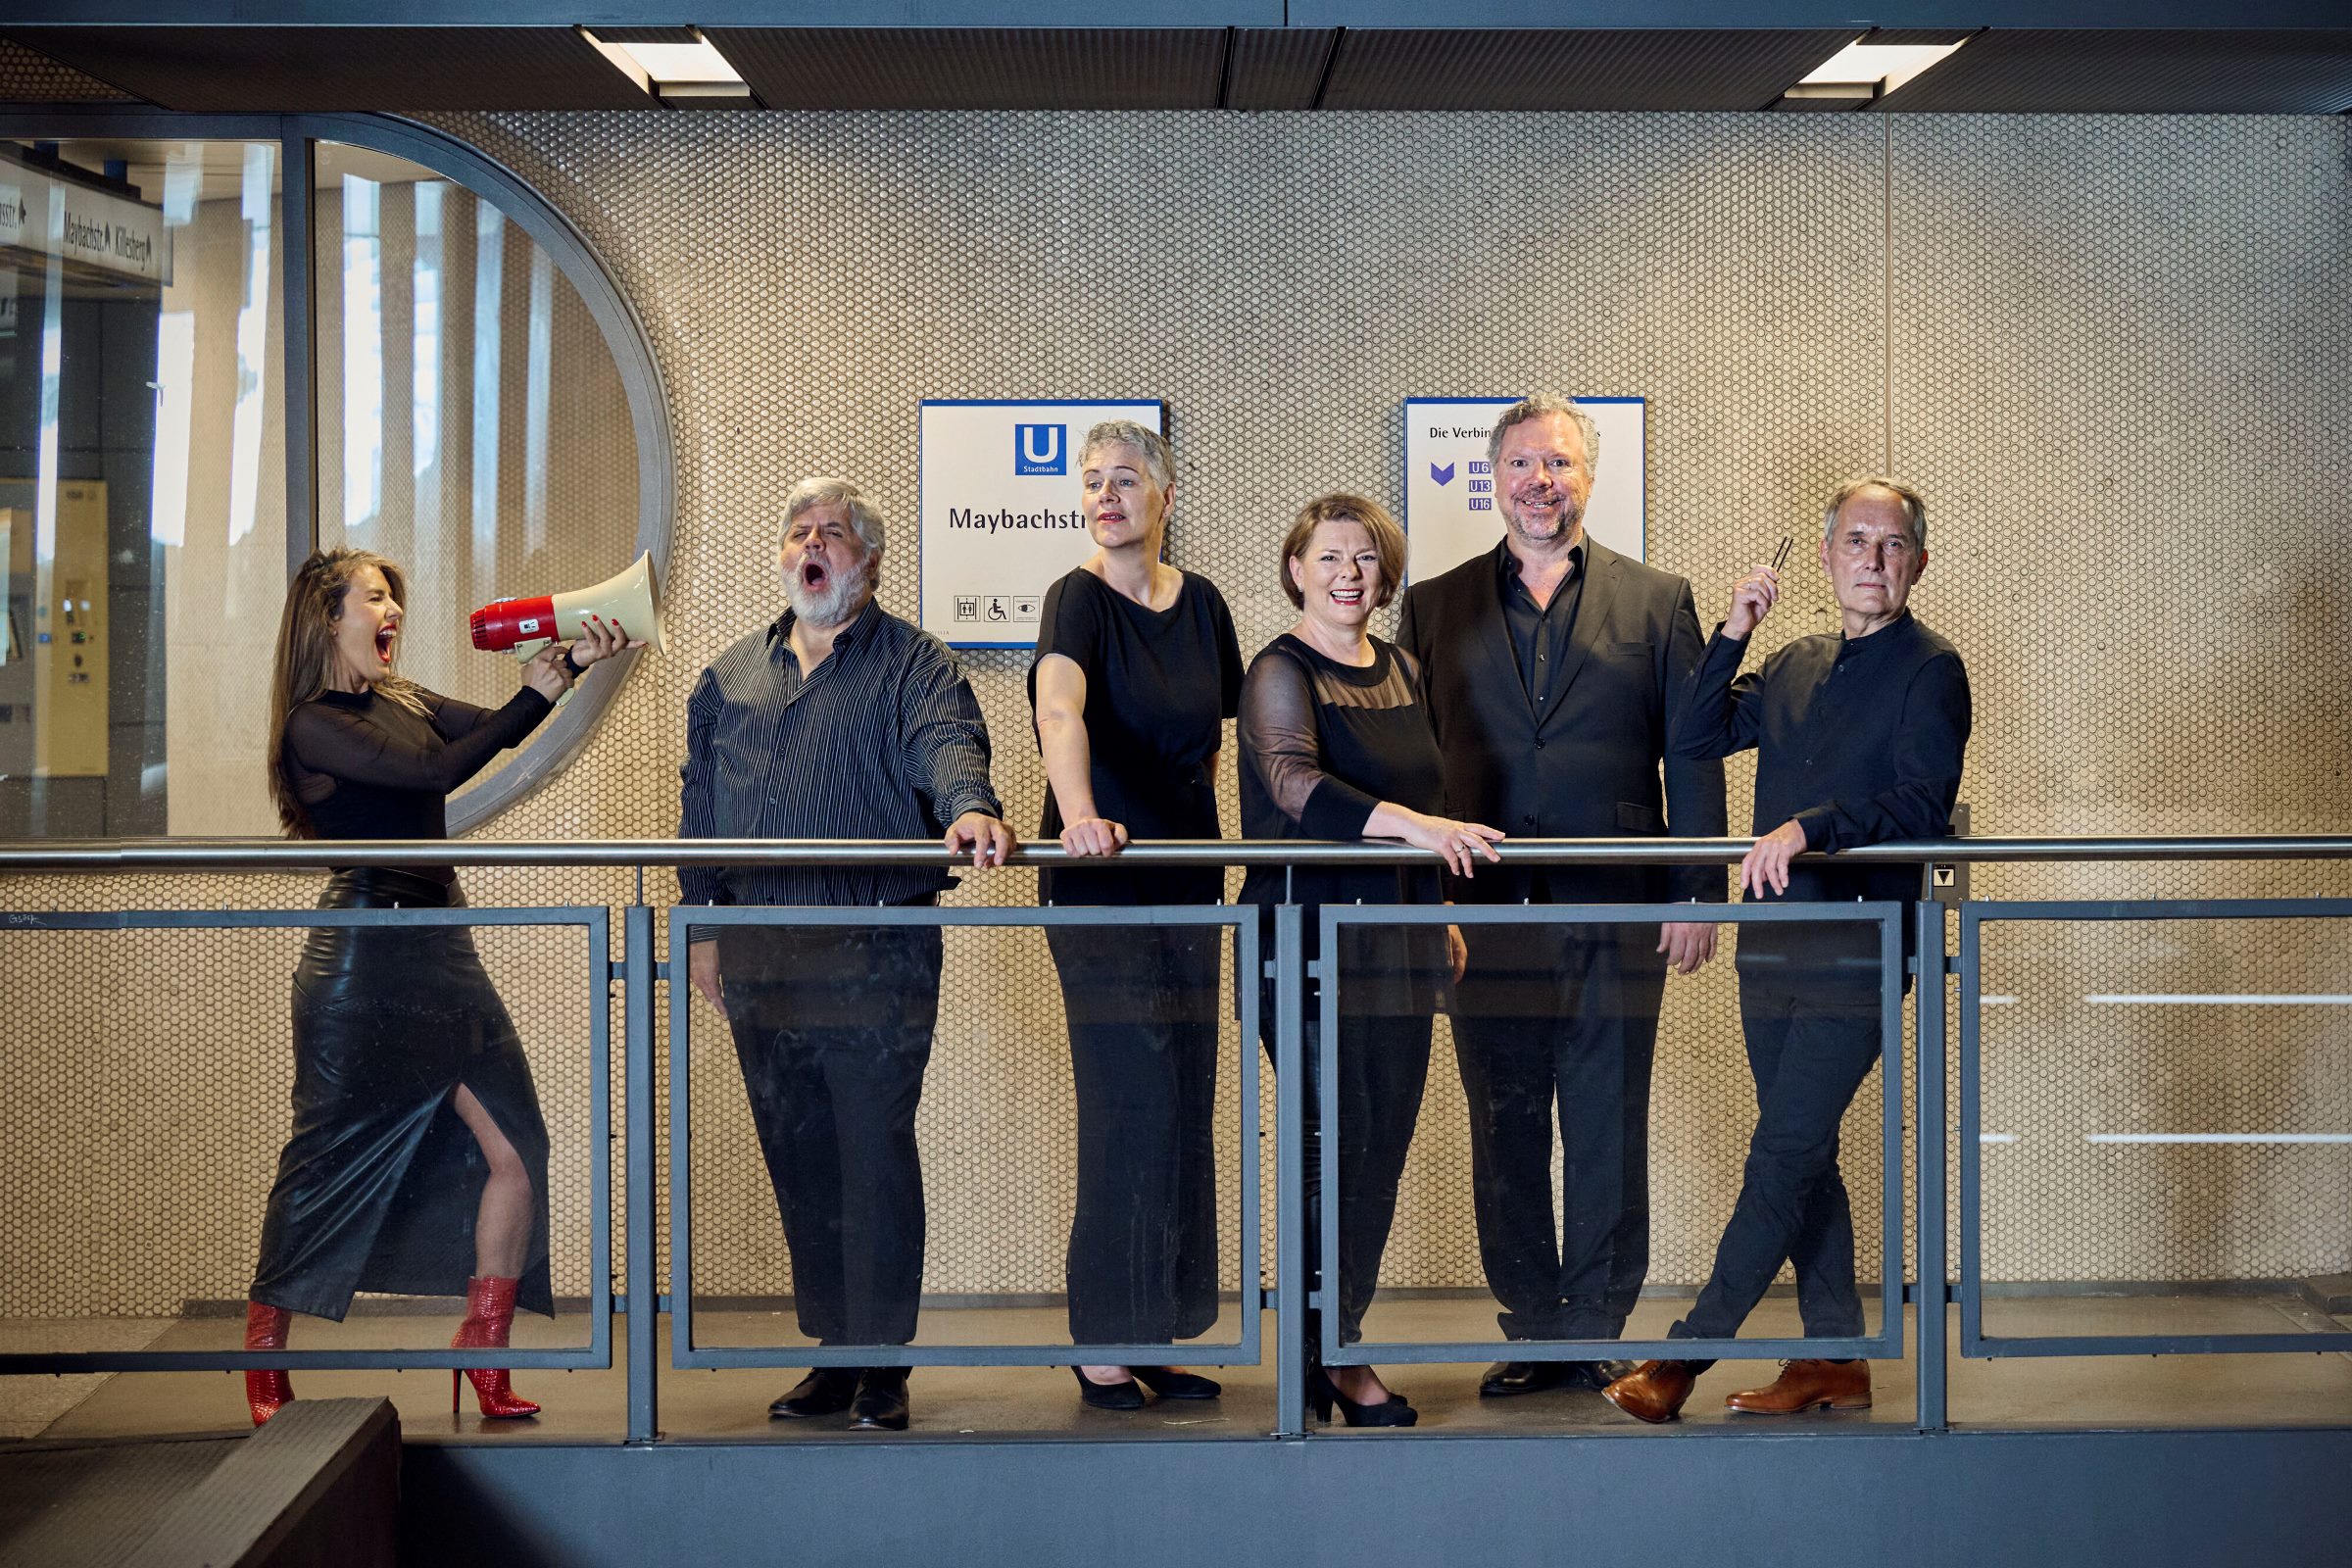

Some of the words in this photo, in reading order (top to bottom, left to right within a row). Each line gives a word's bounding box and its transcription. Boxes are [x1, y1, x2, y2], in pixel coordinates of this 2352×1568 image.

[64, 211, 105, 255] Maybachstr.
[115, 225, 146, 271] Killesberg
[1023, 426, 1058, 464] U
[1430, 427, 1448, 438] Die
[1470, 480, 1491, 492] U13
[1471, 499, 1491, 510] U16
